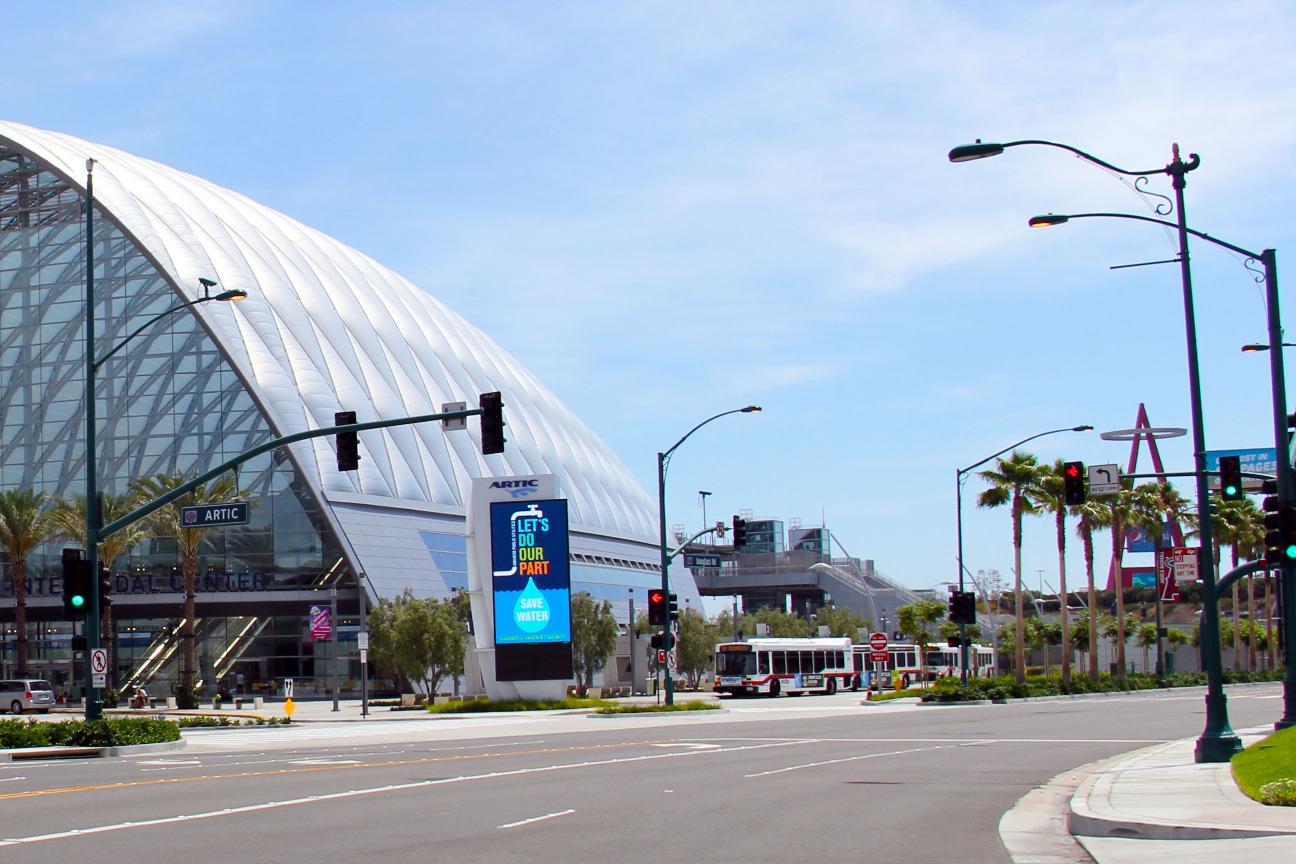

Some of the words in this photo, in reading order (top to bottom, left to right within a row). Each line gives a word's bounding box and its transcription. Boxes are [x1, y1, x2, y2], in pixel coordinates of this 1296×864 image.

[489, 479, 539, 489] ARTIC
[205, 508, 239, 521] ARTIC
[517, 518, 549, 533] LET'S
[518, 533, 535, 547] DO
[519, 547, 544, 561] OUR
[519, 560, 550, 575] PART
[10, 575, 161, 597] INTEDAL
[169, 571, 268, 594] CNTER
[521, 597, 544, 609] SAVE
[516, 610, 549, 622] WATER
